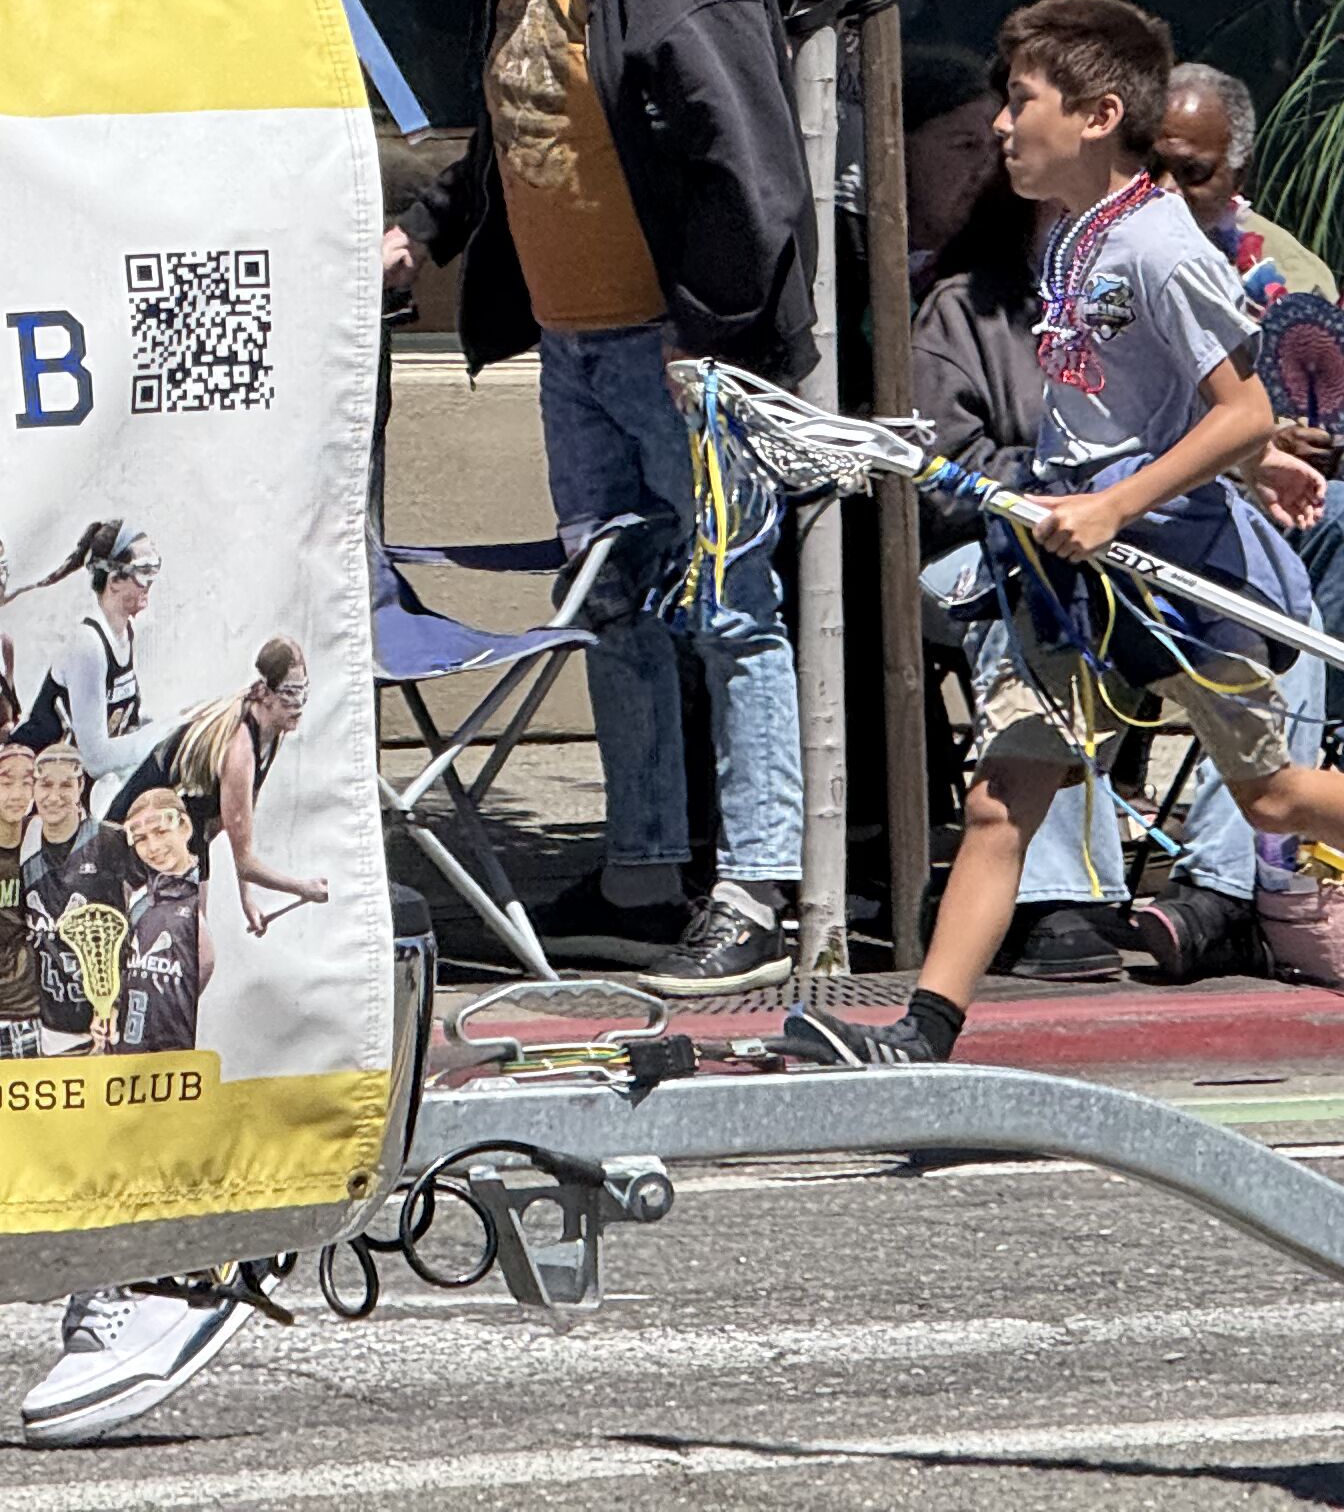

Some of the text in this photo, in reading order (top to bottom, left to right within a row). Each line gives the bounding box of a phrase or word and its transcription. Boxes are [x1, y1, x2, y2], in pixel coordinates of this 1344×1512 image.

[1106, 544, 1166, 577] STX
[0, 1071, 202, 1111] SSE CLUB
